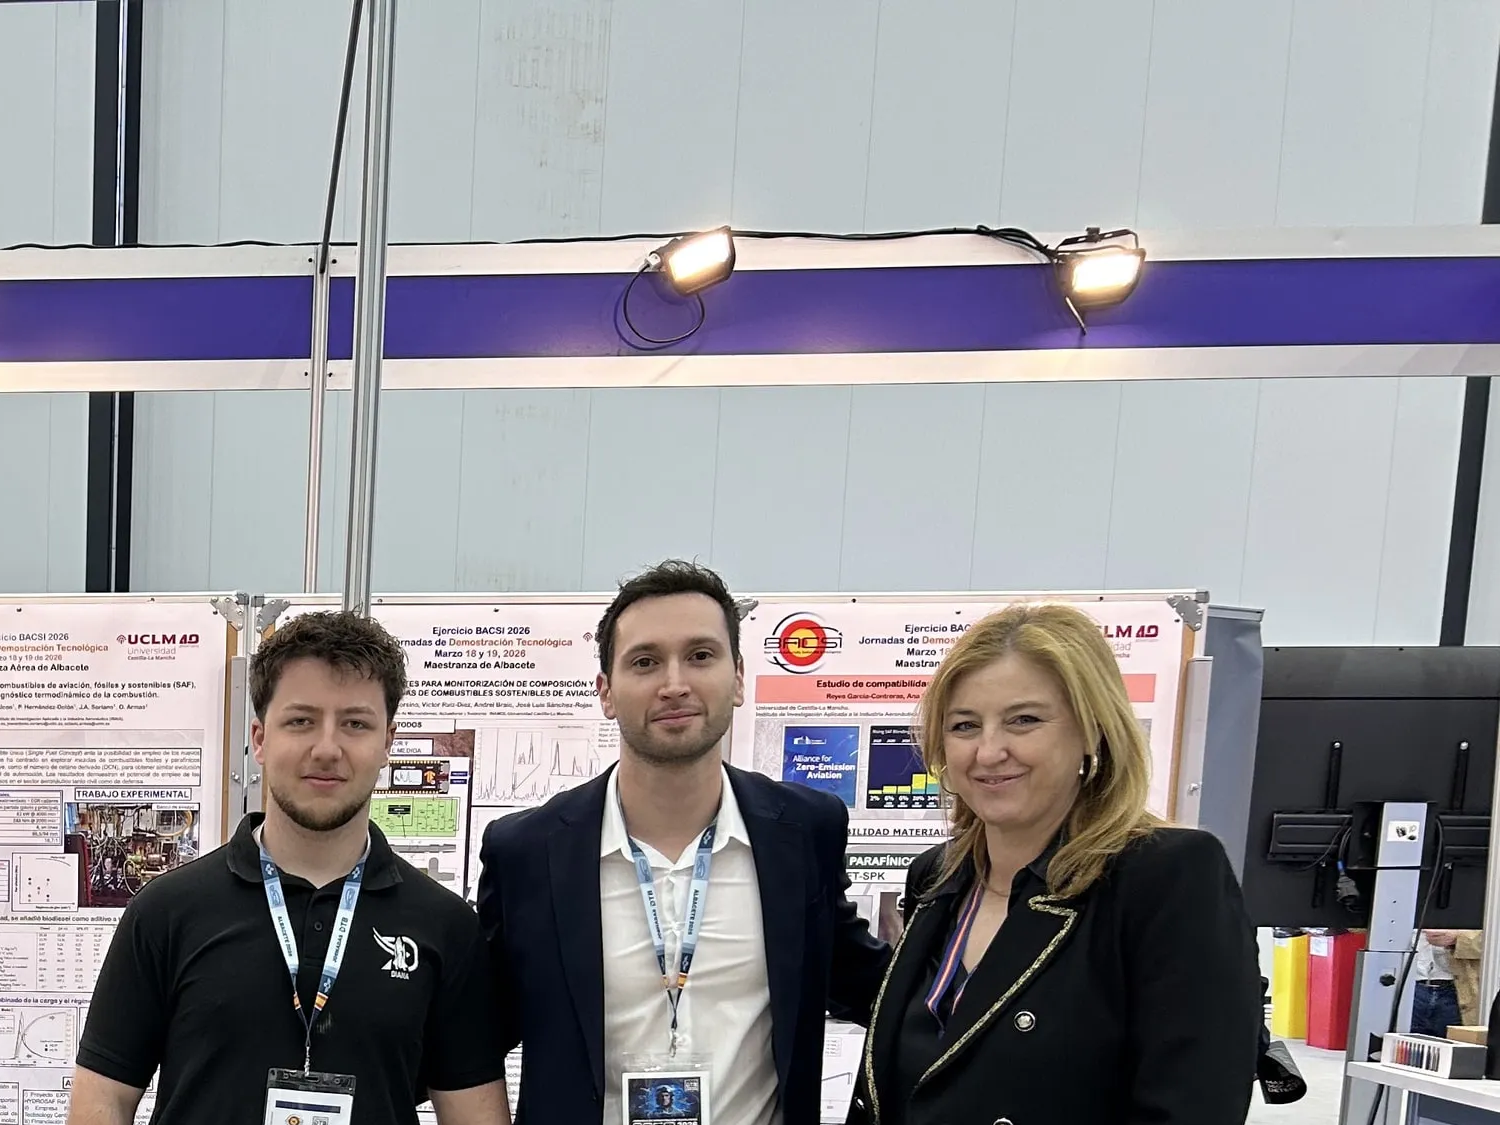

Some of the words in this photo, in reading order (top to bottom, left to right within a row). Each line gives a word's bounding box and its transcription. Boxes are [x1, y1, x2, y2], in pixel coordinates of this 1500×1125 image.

[432, 627, 473, 636] Ejercicio
[507, 627, 530, 635] 2026
[905, 625, 948, 634] Ejercicio
[1097, 625, 1133, 638] LM
[127, 634, 176, 645] UCLM
[449, 638, 514, 646] Demostración
[517, 638, 573, 648] Tecnológica
[764, 637, 843, 649] BACSI
[922, 636, 962, 646] Demos
[57, 644, 109, 653] Tecnológica
[127, 647, 176, 655] Universidad
[488, 650, 500, 658] 19,
[895, 659, 942, 668] Maestran
[817, 680, 851, 688] Estudio
[866, 680, 930, 689] compatibilida
[690, 889, 700, 921] ALBACETE
[338, 917, 349, 933] DTB
[277, 916, 290, 944] ALBACETE
[390, 971, 410, 980] DIANA
